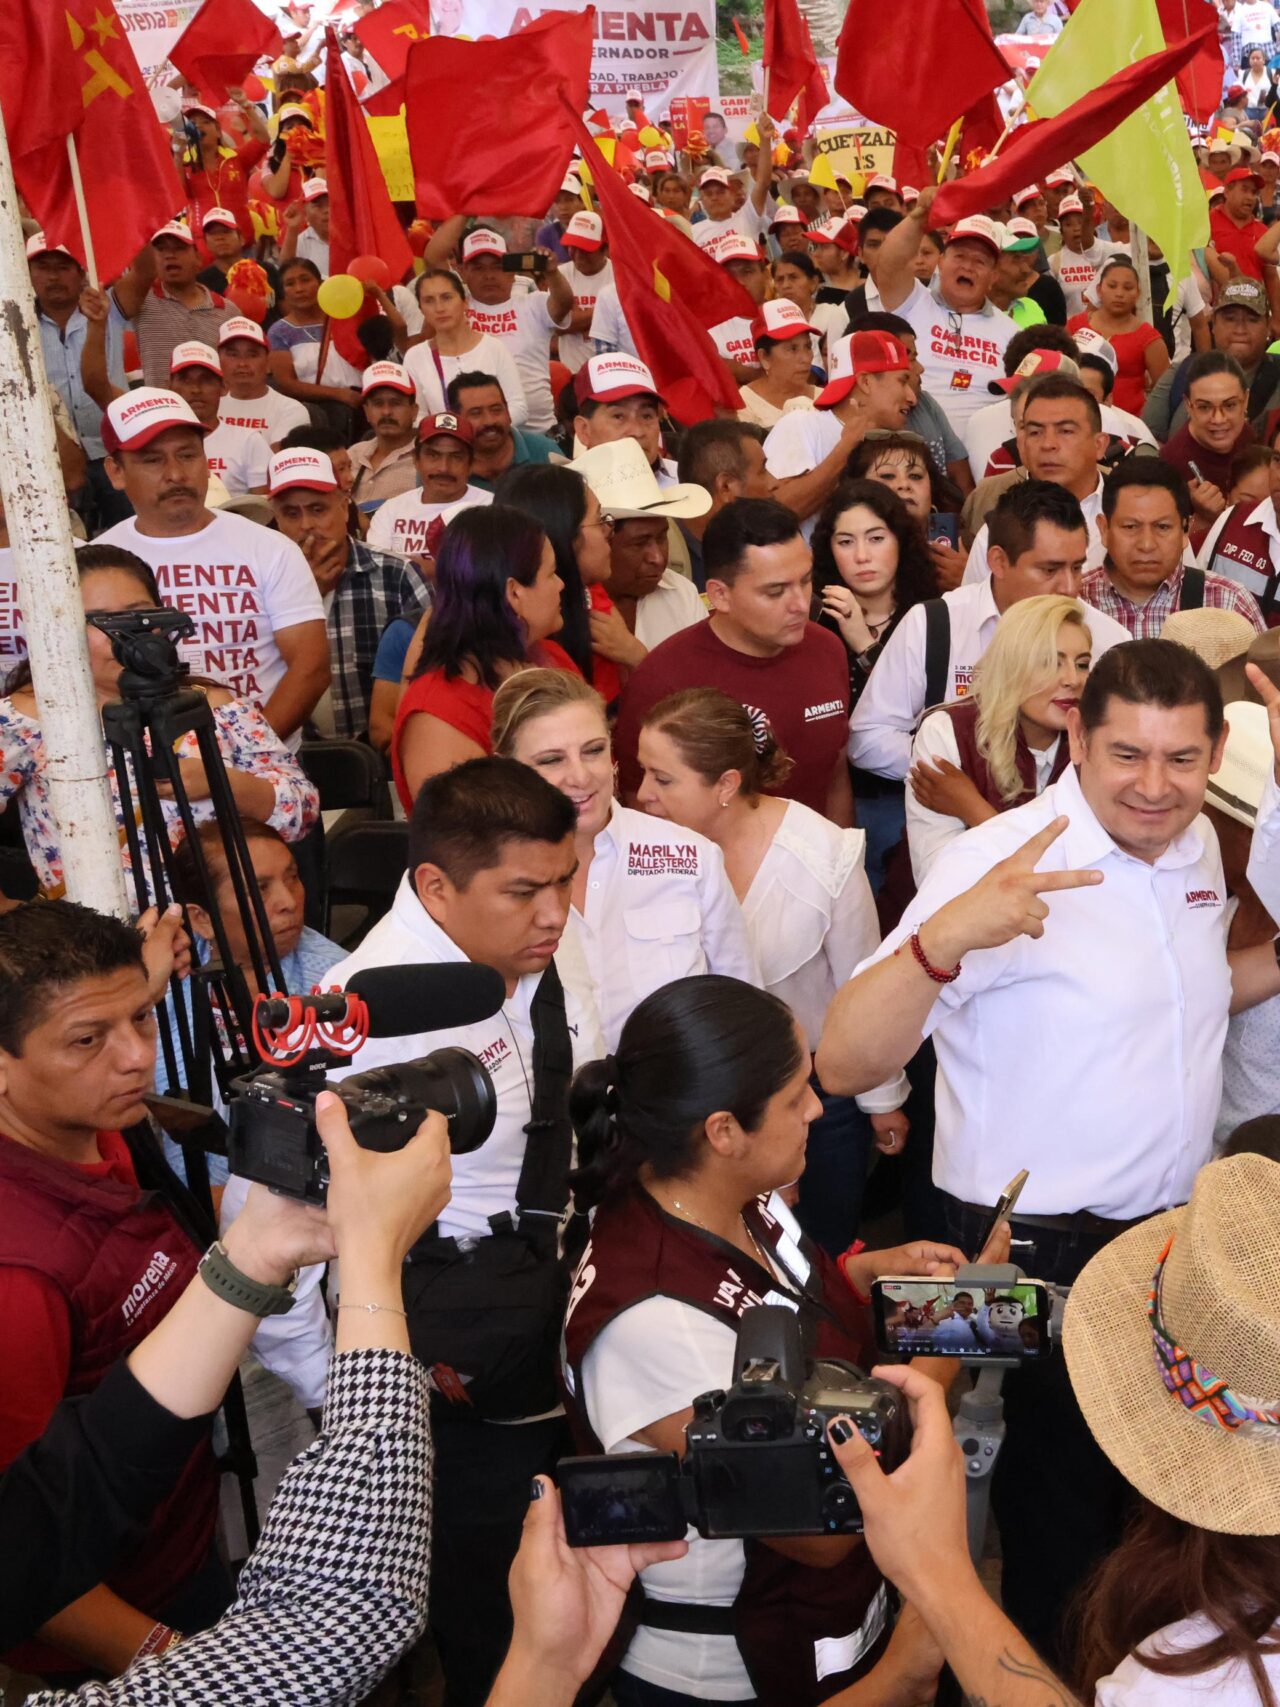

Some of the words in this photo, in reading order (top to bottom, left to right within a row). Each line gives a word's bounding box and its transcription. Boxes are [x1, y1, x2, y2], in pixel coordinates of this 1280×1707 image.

[120, 10, 166, 33] orena
[508, 7, 710, 41] AENTA
[591, 48, 669, 59] ERNADOR
[621, 70, 678, 82] TRABAJO
[720, 98, 750, 107] GABR
[723, 107, 747, 116] GAR
[1061, 265, 1098, 276] GABRI
[1064, 274, 1094, 284] GARC
[931, 324, 1001, 355] GABRIEL
[930, 340, 999, 367] GARCÍA
[596, 361, 648, 374] ARMENTA
[119, 397, 180, 422] ARMENTA
[219, 416, 269, 430] BRIEL
[273, 456, 321, 474] ARMENTA
[1223, 542, 1237, 557] DIP.
[1238, 549, 1253, 565] FED.
[1255, 557, 1267, 570] 03
[154, 564, 258, 589] MENTA
[160, 591, 259, 616] MENTA
[182, 619, 259, 646] ENTA
[629, 842, 698, 859] MARILYN
[627, 868, 665, 876] DIPUTADO
[667, 868, 699, 877] FEDERAL
[628, 856, 699, 869] BALLESTEROS
[1185, 889, 1220, 904] ARMENTA
[478, 1037, 508, 1065] ENTA
[121, 1251, 170, 1320] morena
[134, 1288, 158, 1319] esperanza
[157, 1280, 166, 1290] de
[138, 1622, 167, 1660] RMEN
